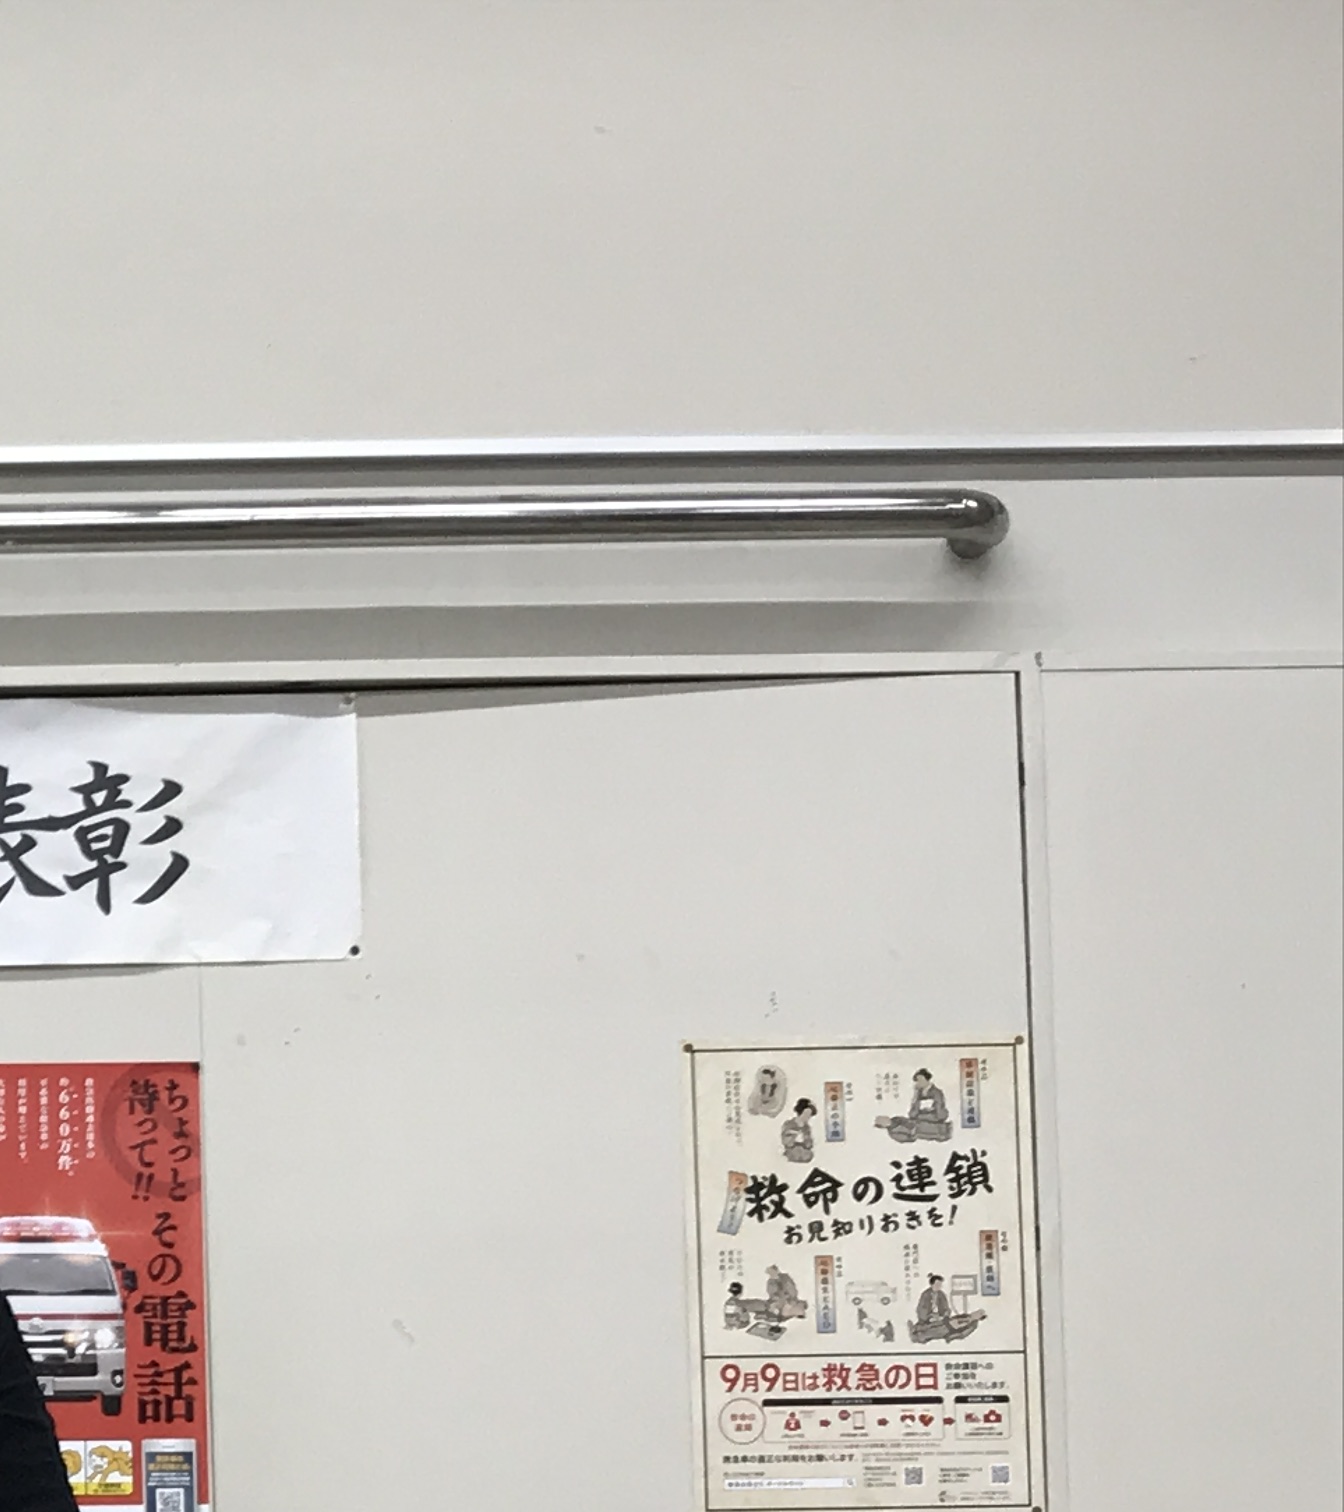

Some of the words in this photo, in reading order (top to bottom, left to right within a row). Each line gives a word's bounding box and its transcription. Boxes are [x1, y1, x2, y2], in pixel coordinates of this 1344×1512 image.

[165, 1078, 192, 1202] ちょっと
[744, 1148, 994, 1223] 救命の連鎖
[783, 1203, 959, 1246] お見知りおきを!
[133, 1211, 200, 1425] その電話
[719, 1362, 939, 1393] 9月9日は救急の日
